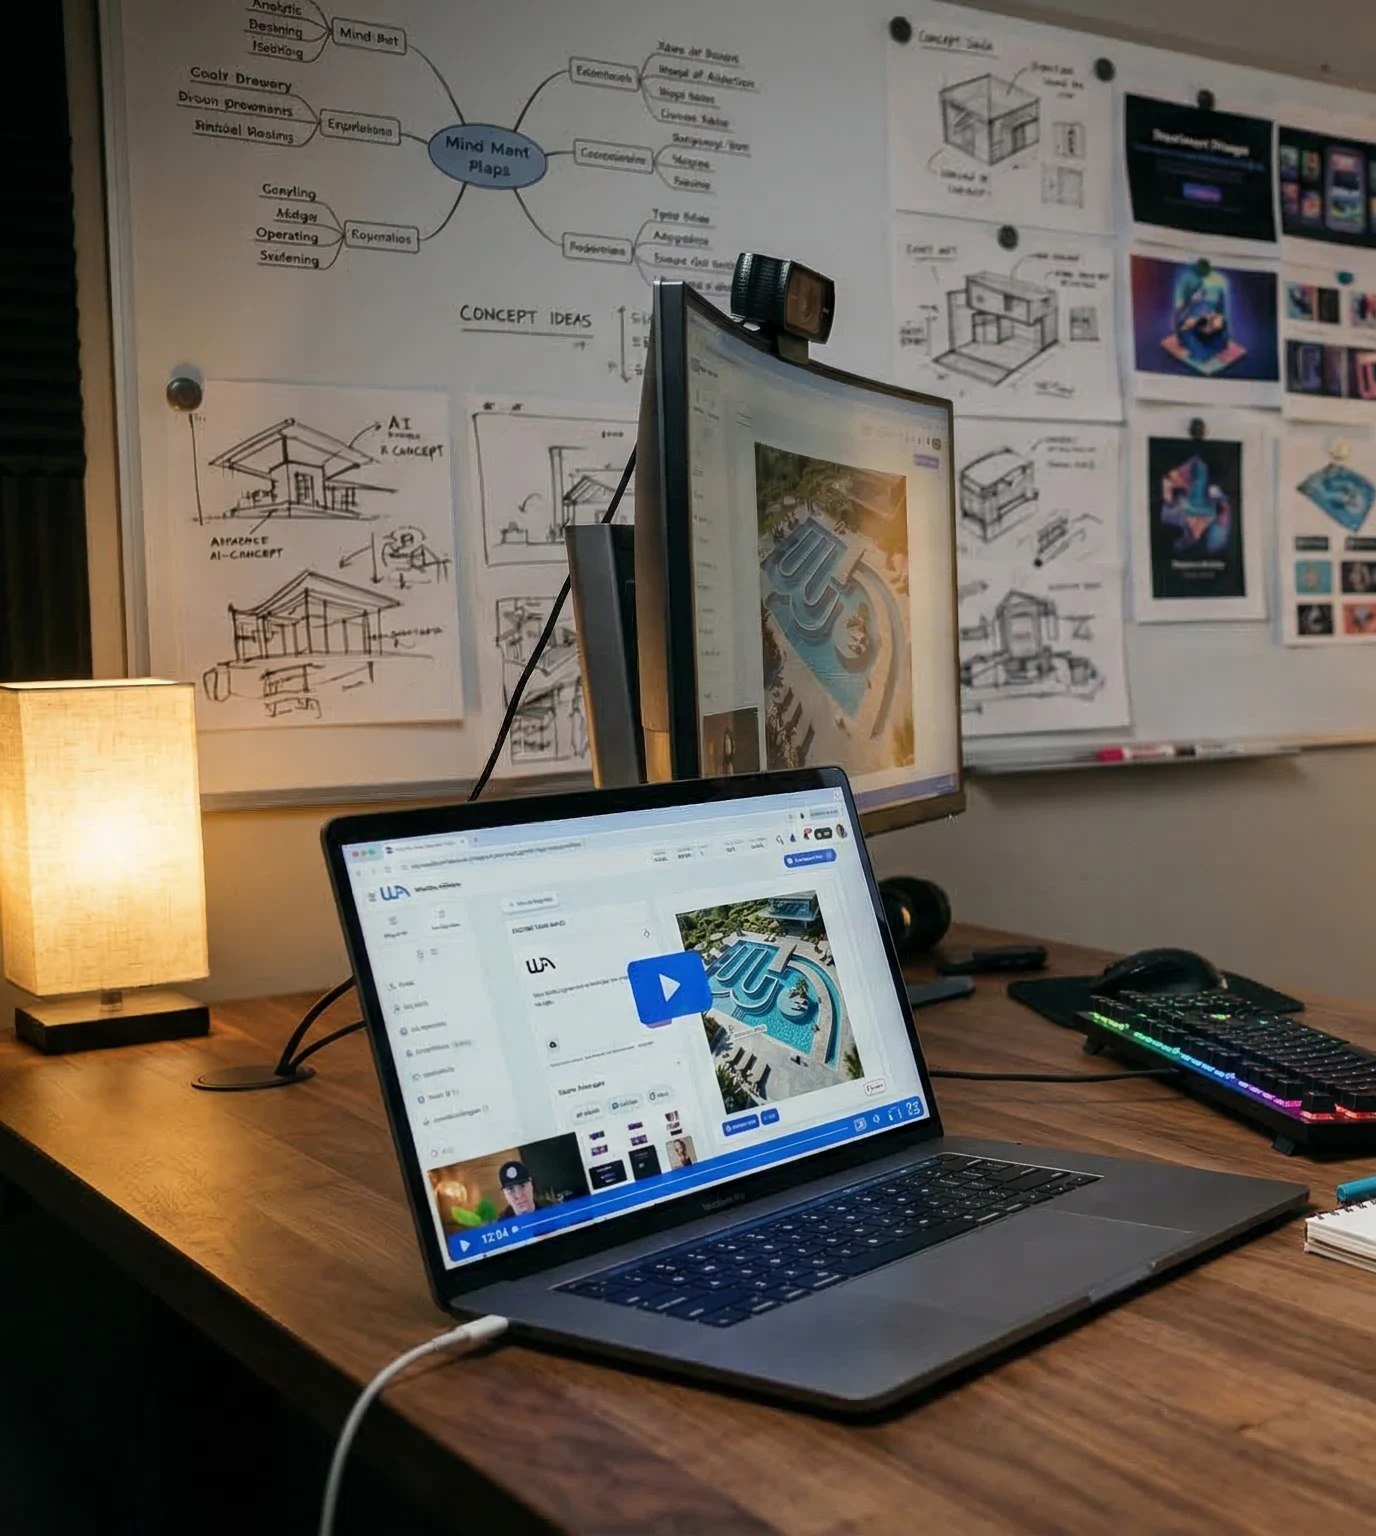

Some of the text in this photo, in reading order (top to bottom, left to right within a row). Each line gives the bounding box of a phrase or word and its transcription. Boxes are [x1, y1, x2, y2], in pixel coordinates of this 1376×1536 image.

[340, 27, 371, 43] Mind
[446, 136, 484, 154] Mind
[256, 226, 319, 245] Operating
[460, 305, 592, 328] CONCEPT IDEAS
[388, 416, 412, 431] AI
